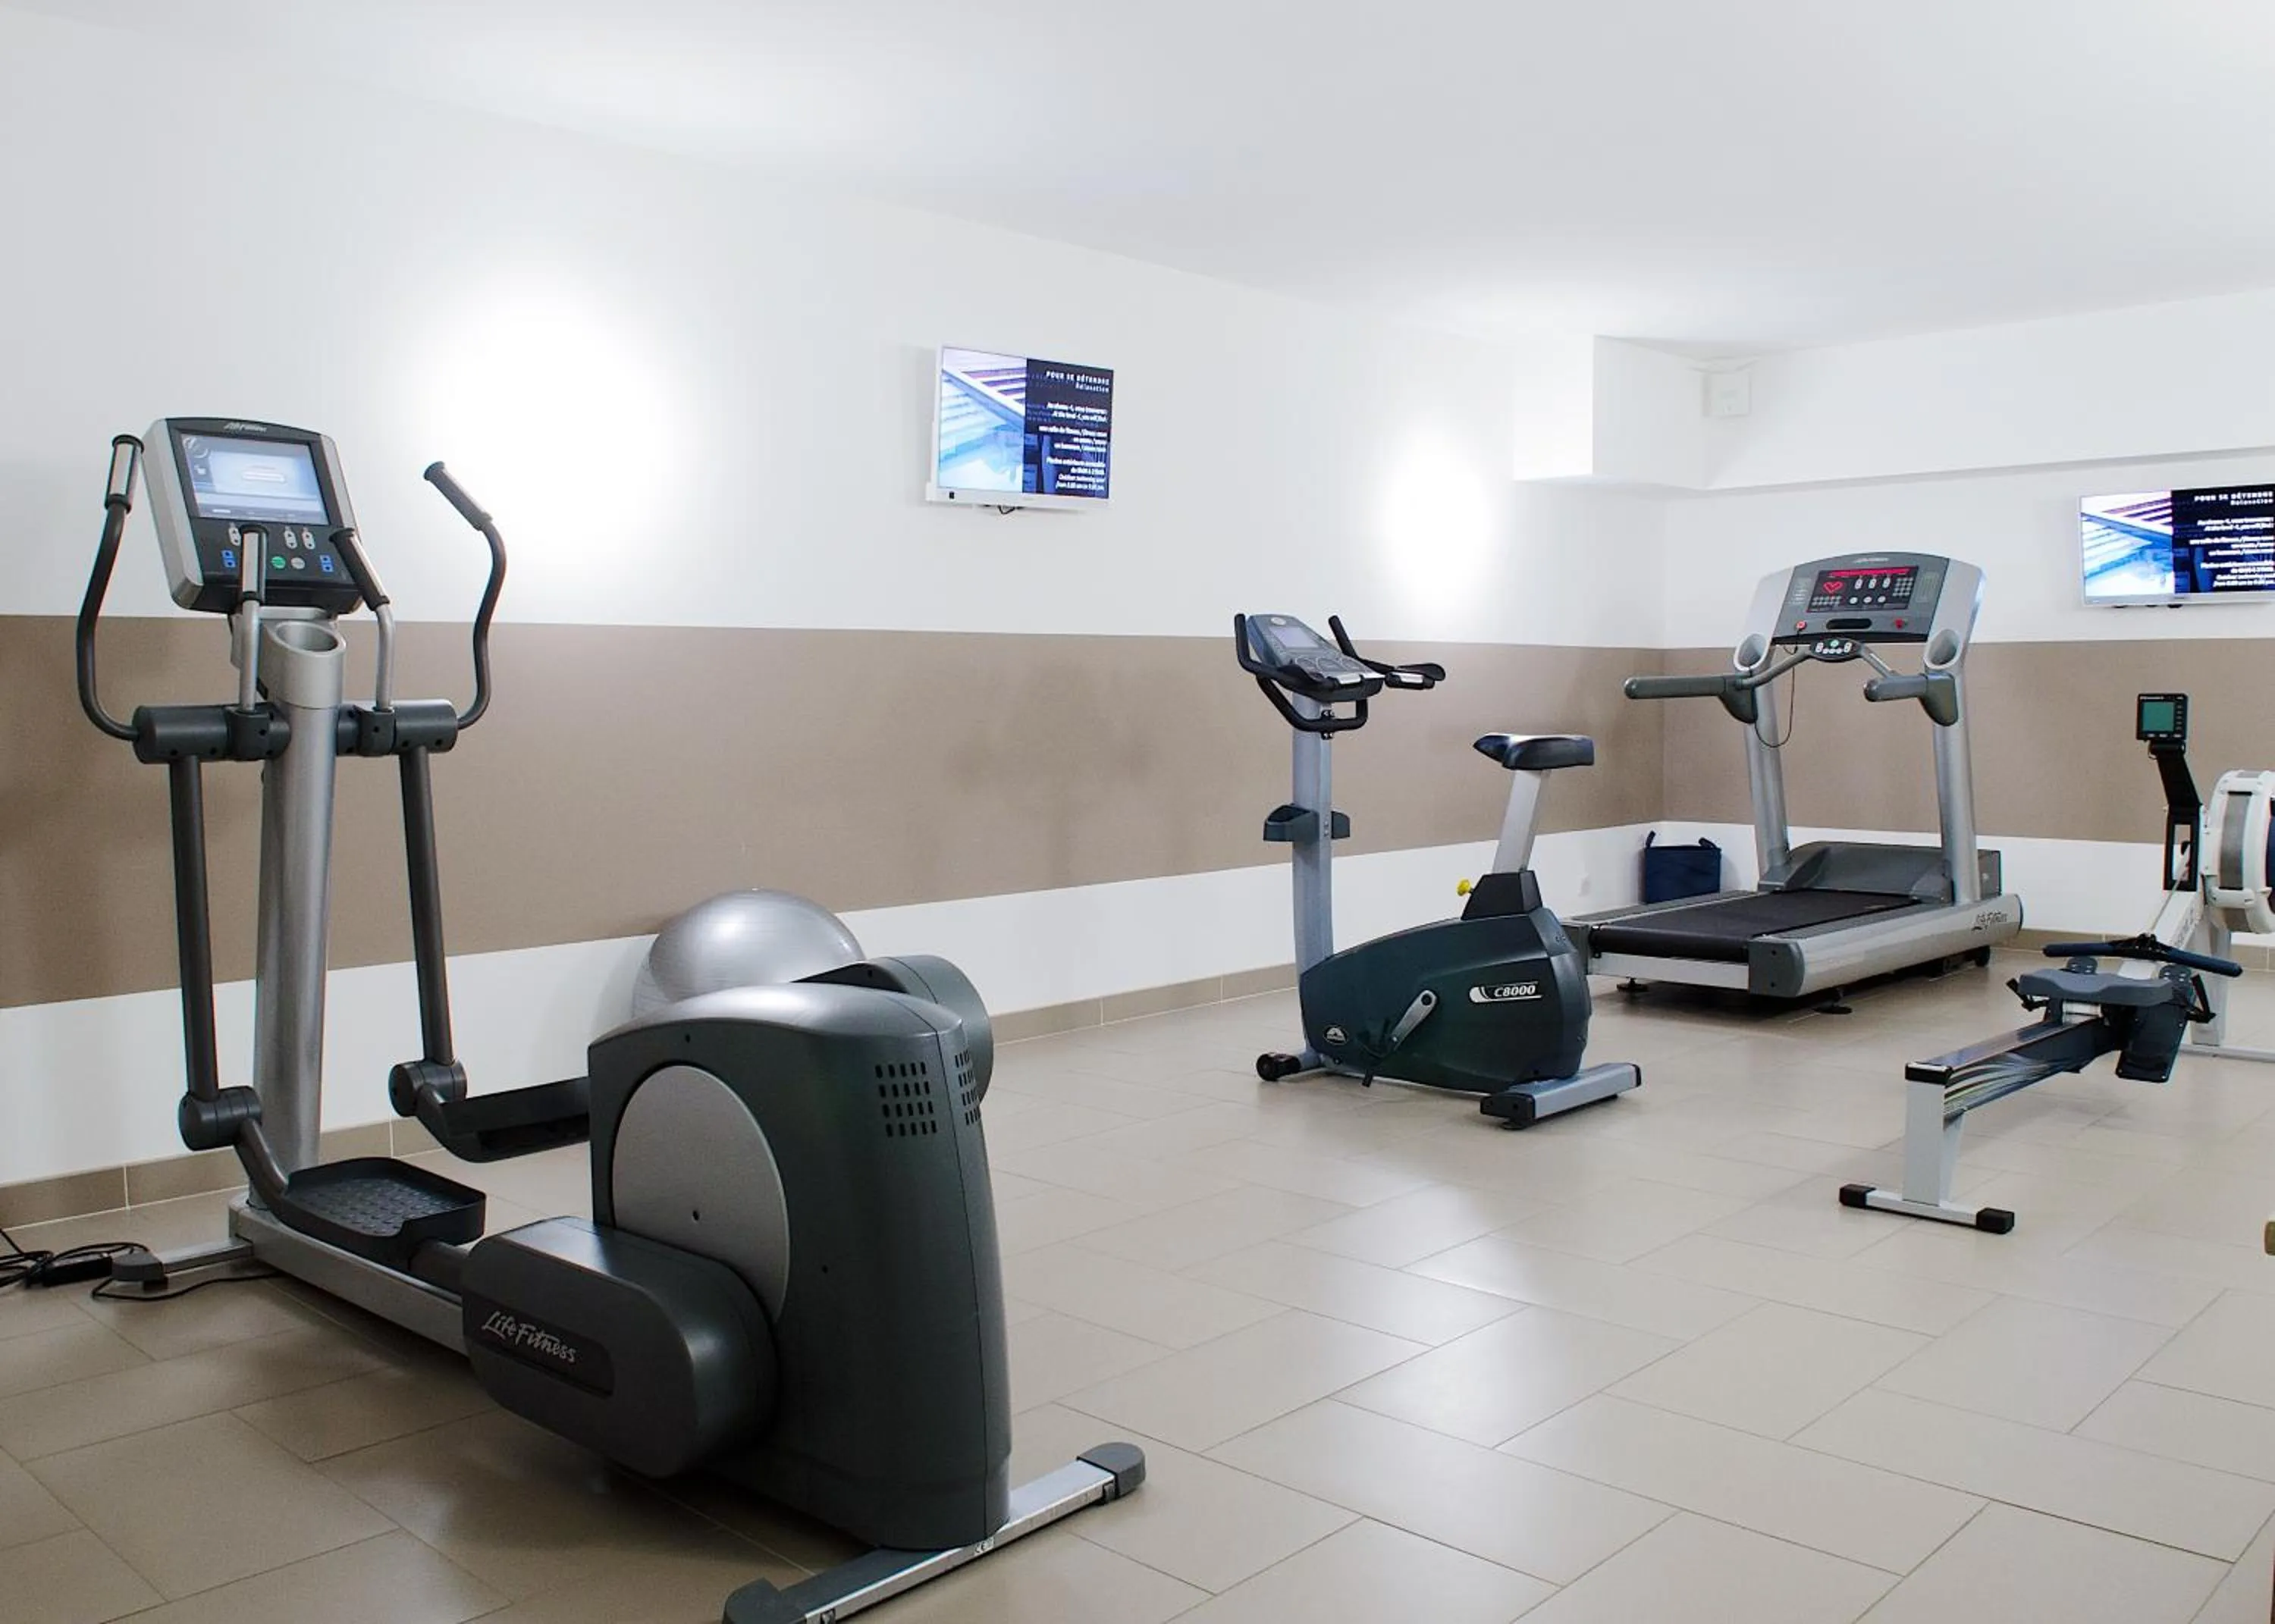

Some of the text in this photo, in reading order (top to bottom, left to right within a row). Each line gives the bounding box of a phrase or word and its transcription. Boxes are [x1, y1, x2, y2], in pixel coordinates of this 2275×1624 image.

[1046, 371, 1065, 380] POUR
[1066, 372, 1075, 381] SE
[1494, 985, 1536, 997] C8000
[481, 1311, 578, 1363] Life Fitness
